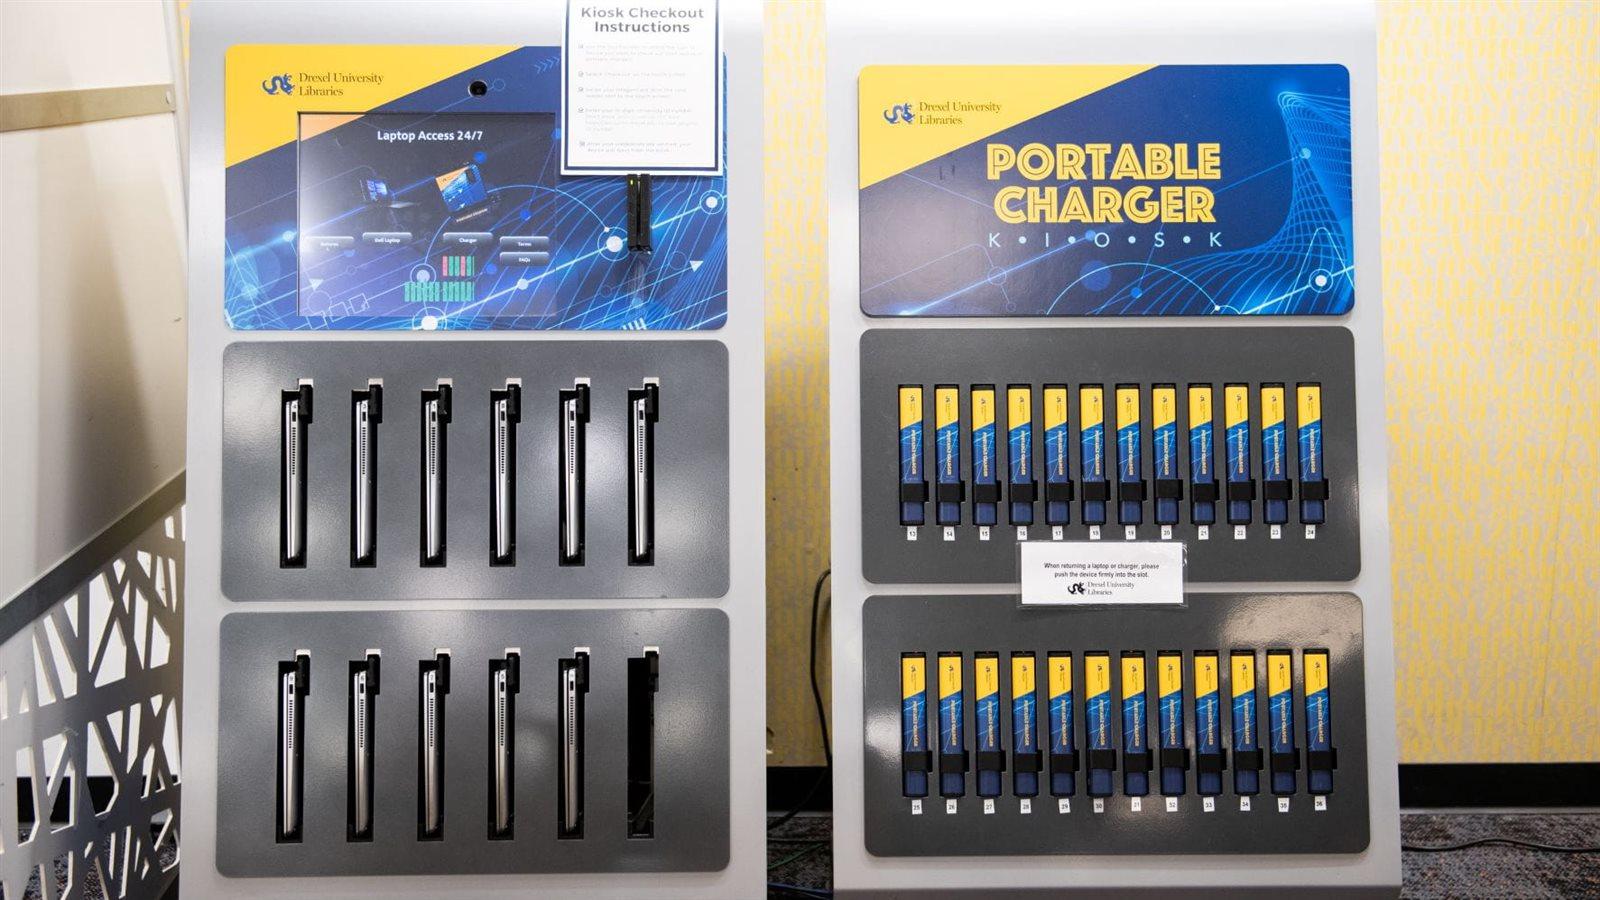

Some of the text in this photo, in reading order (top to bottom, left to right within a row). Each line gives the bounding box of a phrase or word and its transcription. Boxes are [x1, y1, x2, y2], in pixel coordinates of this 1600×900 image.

[581, 6, 704, 19] Kiosk Checkout
[594, 20, 690, 33] Instructions
[299, 72, 383, 86] Drexel University
[299, 85, 344, 97] Libraries
[919, 101, 1002, 115] Drexel University
[919, 114, 963, 126] Libraries
[377, 130, 483, 143] Laptop Access 24/7
[986, 142, 1221, 181] PORTABLE
[993, 185, 1216, 224] CHARGER
[1061, 562, 1086, 570] returning
[1092, 562, 1109, 570] laptop
[1098, 571, 1114, 579] firmly
